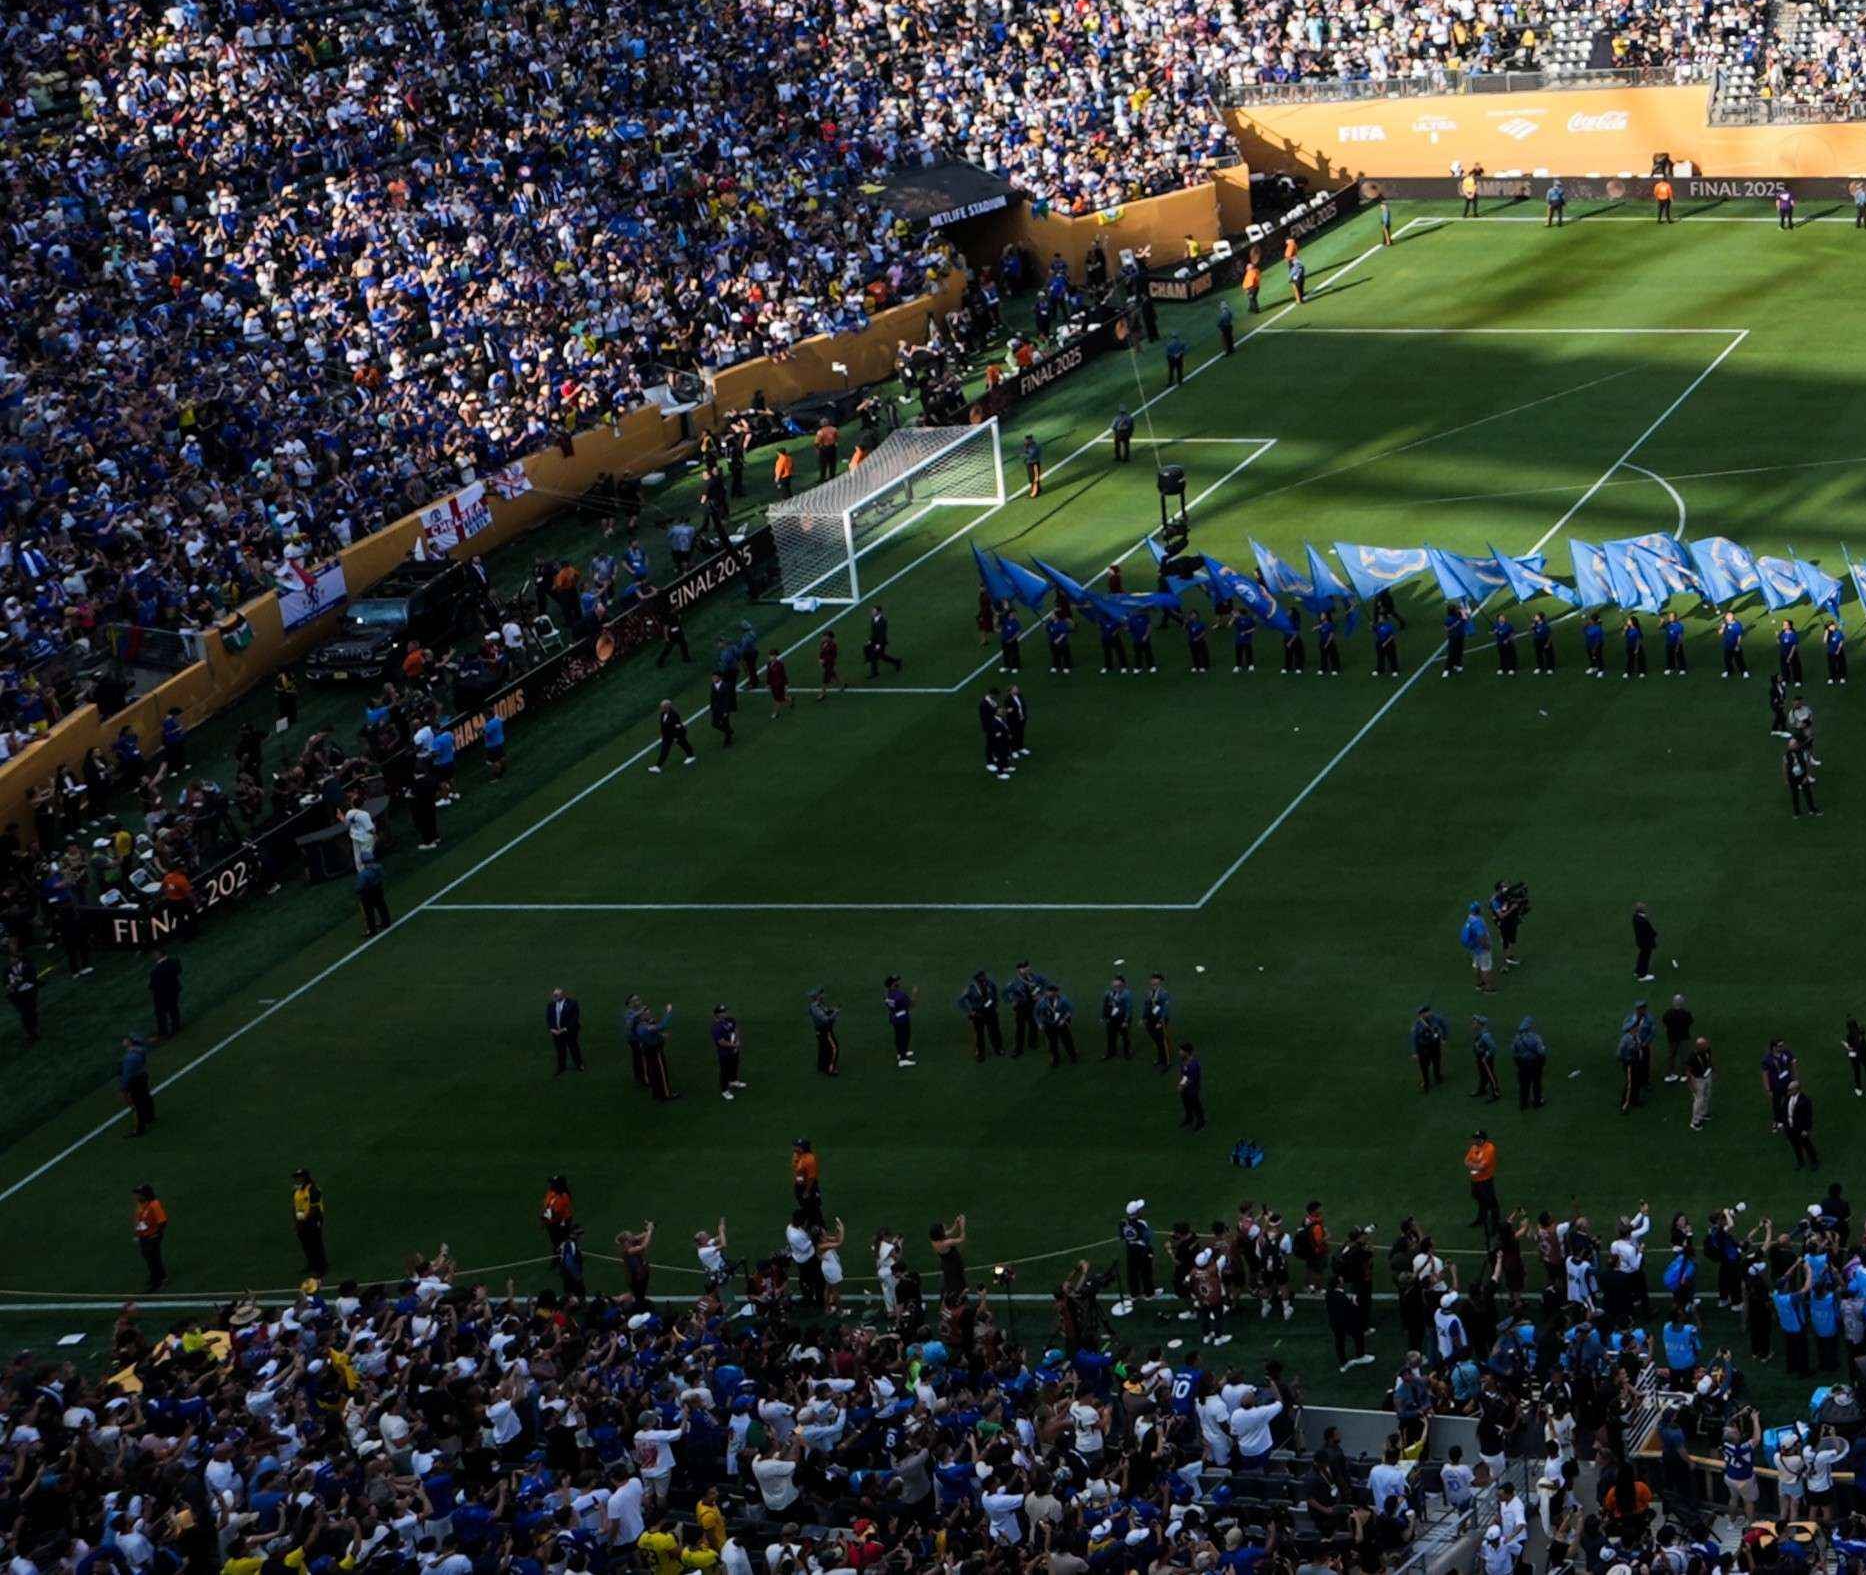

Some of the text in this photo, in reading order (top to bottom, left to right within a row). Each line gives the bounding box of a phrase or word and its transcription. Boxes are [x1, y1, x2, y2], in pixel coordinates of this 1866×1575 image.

[1567, 110, 1630, 133] Coca-Cola
[1338, 124, 1388, 143] FIFA
[1689, 181, 1785, 197] FINAL 2025
[929, 206, 968, 227] METLIFE
[1021, 346, 1082, 395] FINAL 2025
[669, 569, 717, 608] FINAL
[205, 861, 249, 907] 202
[1171, 1380, 1190, 1399] 10
